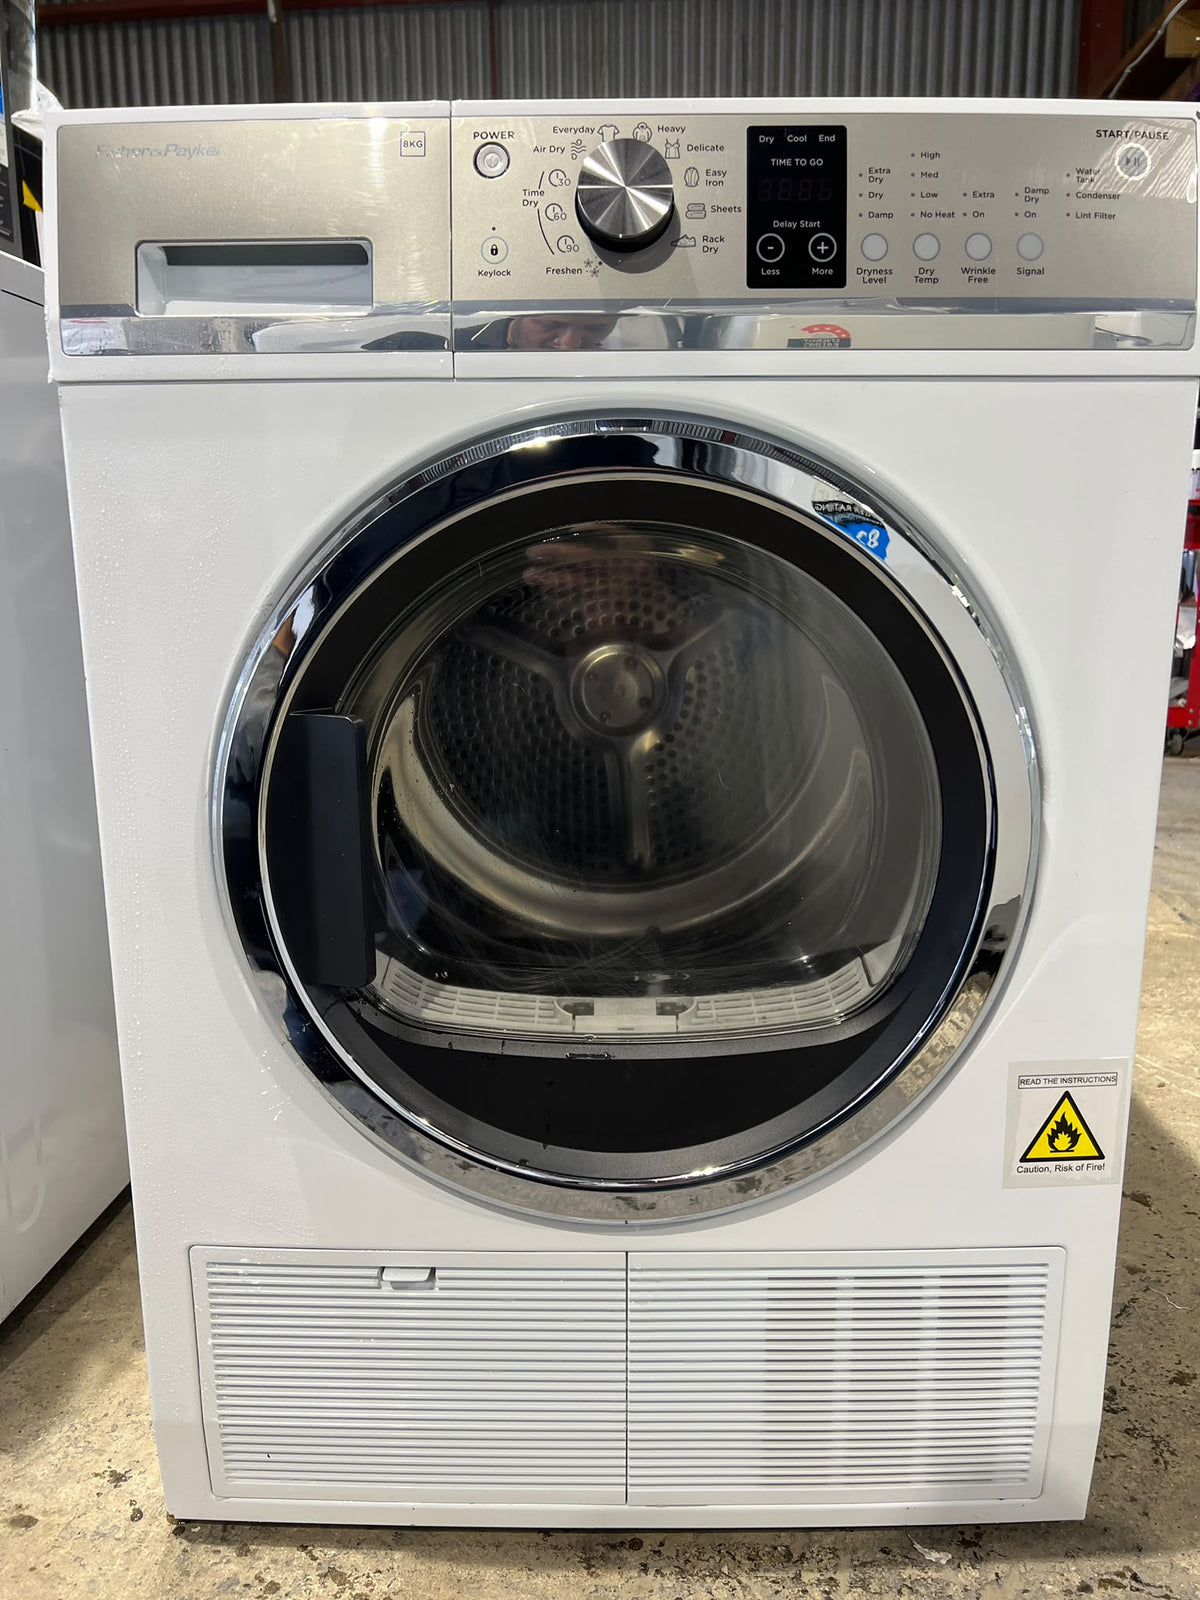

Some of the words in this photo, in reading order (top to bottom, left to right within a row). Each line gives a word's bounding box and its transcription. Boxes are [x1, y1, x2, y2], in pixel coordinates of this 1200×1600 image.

[473, 130, 515, 140] POWER
[552, 125, 596, 135] Everyday
[657, 125, 686, 135] Heavy
[1096, 129, 1170, 140] START/PAUSE
[758, 134, 775, 144] Dry
[787, 134, 808, 143] Cool
[818, 134, 836, 143] End
[402, 139, 424, 149] 8KG
[687, 143, 725, 152] Delicate
[533, 144, 548, 153] Air
[550, 145, 566, 155] Dry
[920, 150, 941, 161] High
[770, 158, 792, 167] TIME
[794, 158, 808, 167] TO
[809, 158, 824, 167] GO
[705, 169, 728, 179] Easy
[868, 167, 891, 176] Extra
[920, 170, 939, 179] Med
[705, 178, 724, 187] Iron
[868, 175, 884, 185] Dry
[522, 189, 545, 197] Time
[868, 190, 884, 200] Dry
[920, 190, 939, 200] Low
[972, 190, 995, 200] Extra
[1024, 186, 1050, 196] Damp
[1075, 192, 1120, 200] Condenser
[522, 198, 539, 208] Dry
[1024, 195, 1040, 204] Dry
[710, 204, 742, 213] Sheets
[868, 210, 894, 221] Damp
[920, 210, 932, 219] No
[933, 210, 955, 220] Heat
[972, 210, 986, 220] On
[1024, 210, 1038, 219] On
[1094, 212, 1116, 220] Filter
[772, 219, 797, 230] Delay
[799, 219, 821, 229] Start
[702, 235, 725, 244] Rack
[702, 245, 719, 254] Dry
[477, 269, 512, 277] Keylock
[545, 266, 583, 276] Freshen
[761, 267, 780, 277] Less
[811, 267, 834, 277] More
[856, 267, 893, 277] Dryness
[918, 267, 936, 277] Dry
[960, 266, 996, 277] Wrinkle
[1016, 267, 1045, 277] Signal
[862, 275, 887, 285] Level
[914, 276, 939, 286] Temp
[968, 275, 990, 285] Free
[1060, 1076, 1116, 1084] INSTRUCTIONS
[1016, 1165, 1052, 1174] Caution,
[1054, 1164, 1073, 1172] Risk
[1076, 1164, 1084, 1172] of
[1086, 1163, 1105, 1171] Fire!
